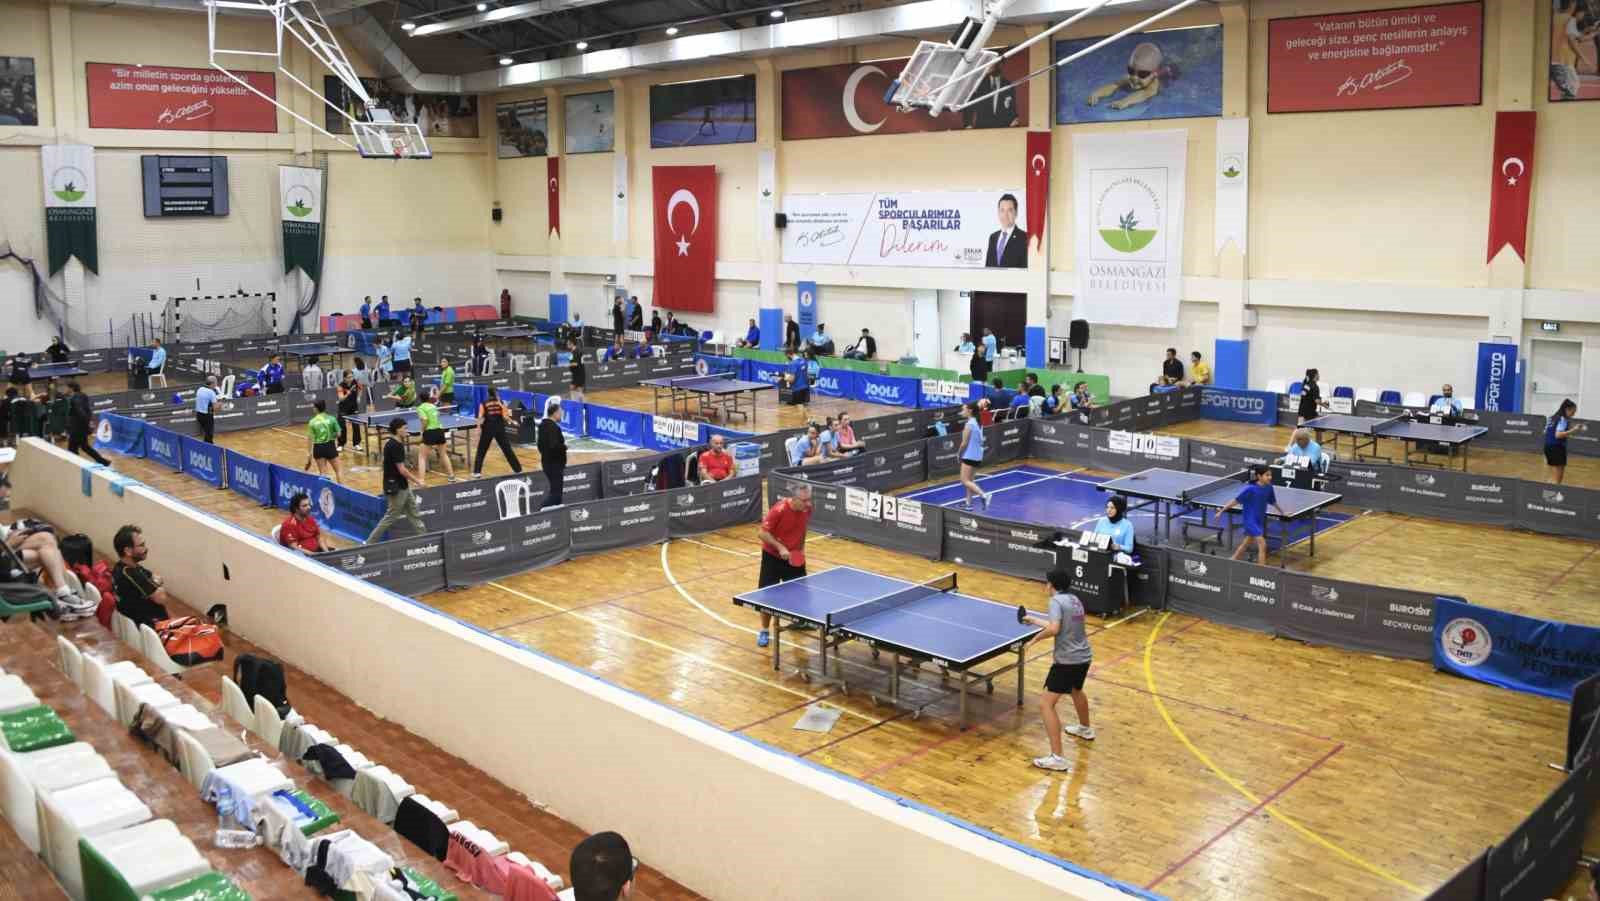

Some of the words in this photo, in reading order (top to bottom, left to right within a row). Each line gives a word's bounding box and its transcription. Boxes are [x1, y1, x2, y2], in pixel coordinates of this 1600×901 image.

[1358, 17, 1389, 29] bütün
[1423, 14, 1437, 23] ve
[1286, 35, 1327, 49] geleceği
[1352, 33, 1378, 45] genç
[1380, 28, 1428, 41] nesillerin
[1430, 25, 1468, 38] anlayış
[1308, 52, 1319, 61] ve
[1321, 48, 1370, 61] enerjisine
[132, 70, 168, 80] milletin
[170, 71, 201, 82] sporda
[110, 82, 133, 91] azim
[135, 84, 160, 92] onun
[161, 83, 208, 95] geleceğini
[878, 197, 898, 209] TÜM
[878, 209, 961, 219] SPORCULARIMIZA
[902, 219, 961, 231] BAŞARILAR
[865, 382, 900, 398] JOOLA
[596, 416, 628, 436] JOOLA
[1136, 438, 1141, 449] 1
[1146, 439, 1154, 450] 0
[190, 451, 214, 473] JOOLA
[235, 465, 260, 489] JOOLA
[871, 497, 879, 513] 2
[885, 500, 894, 516] 2
[1075, 565, 1084, 578] 6
